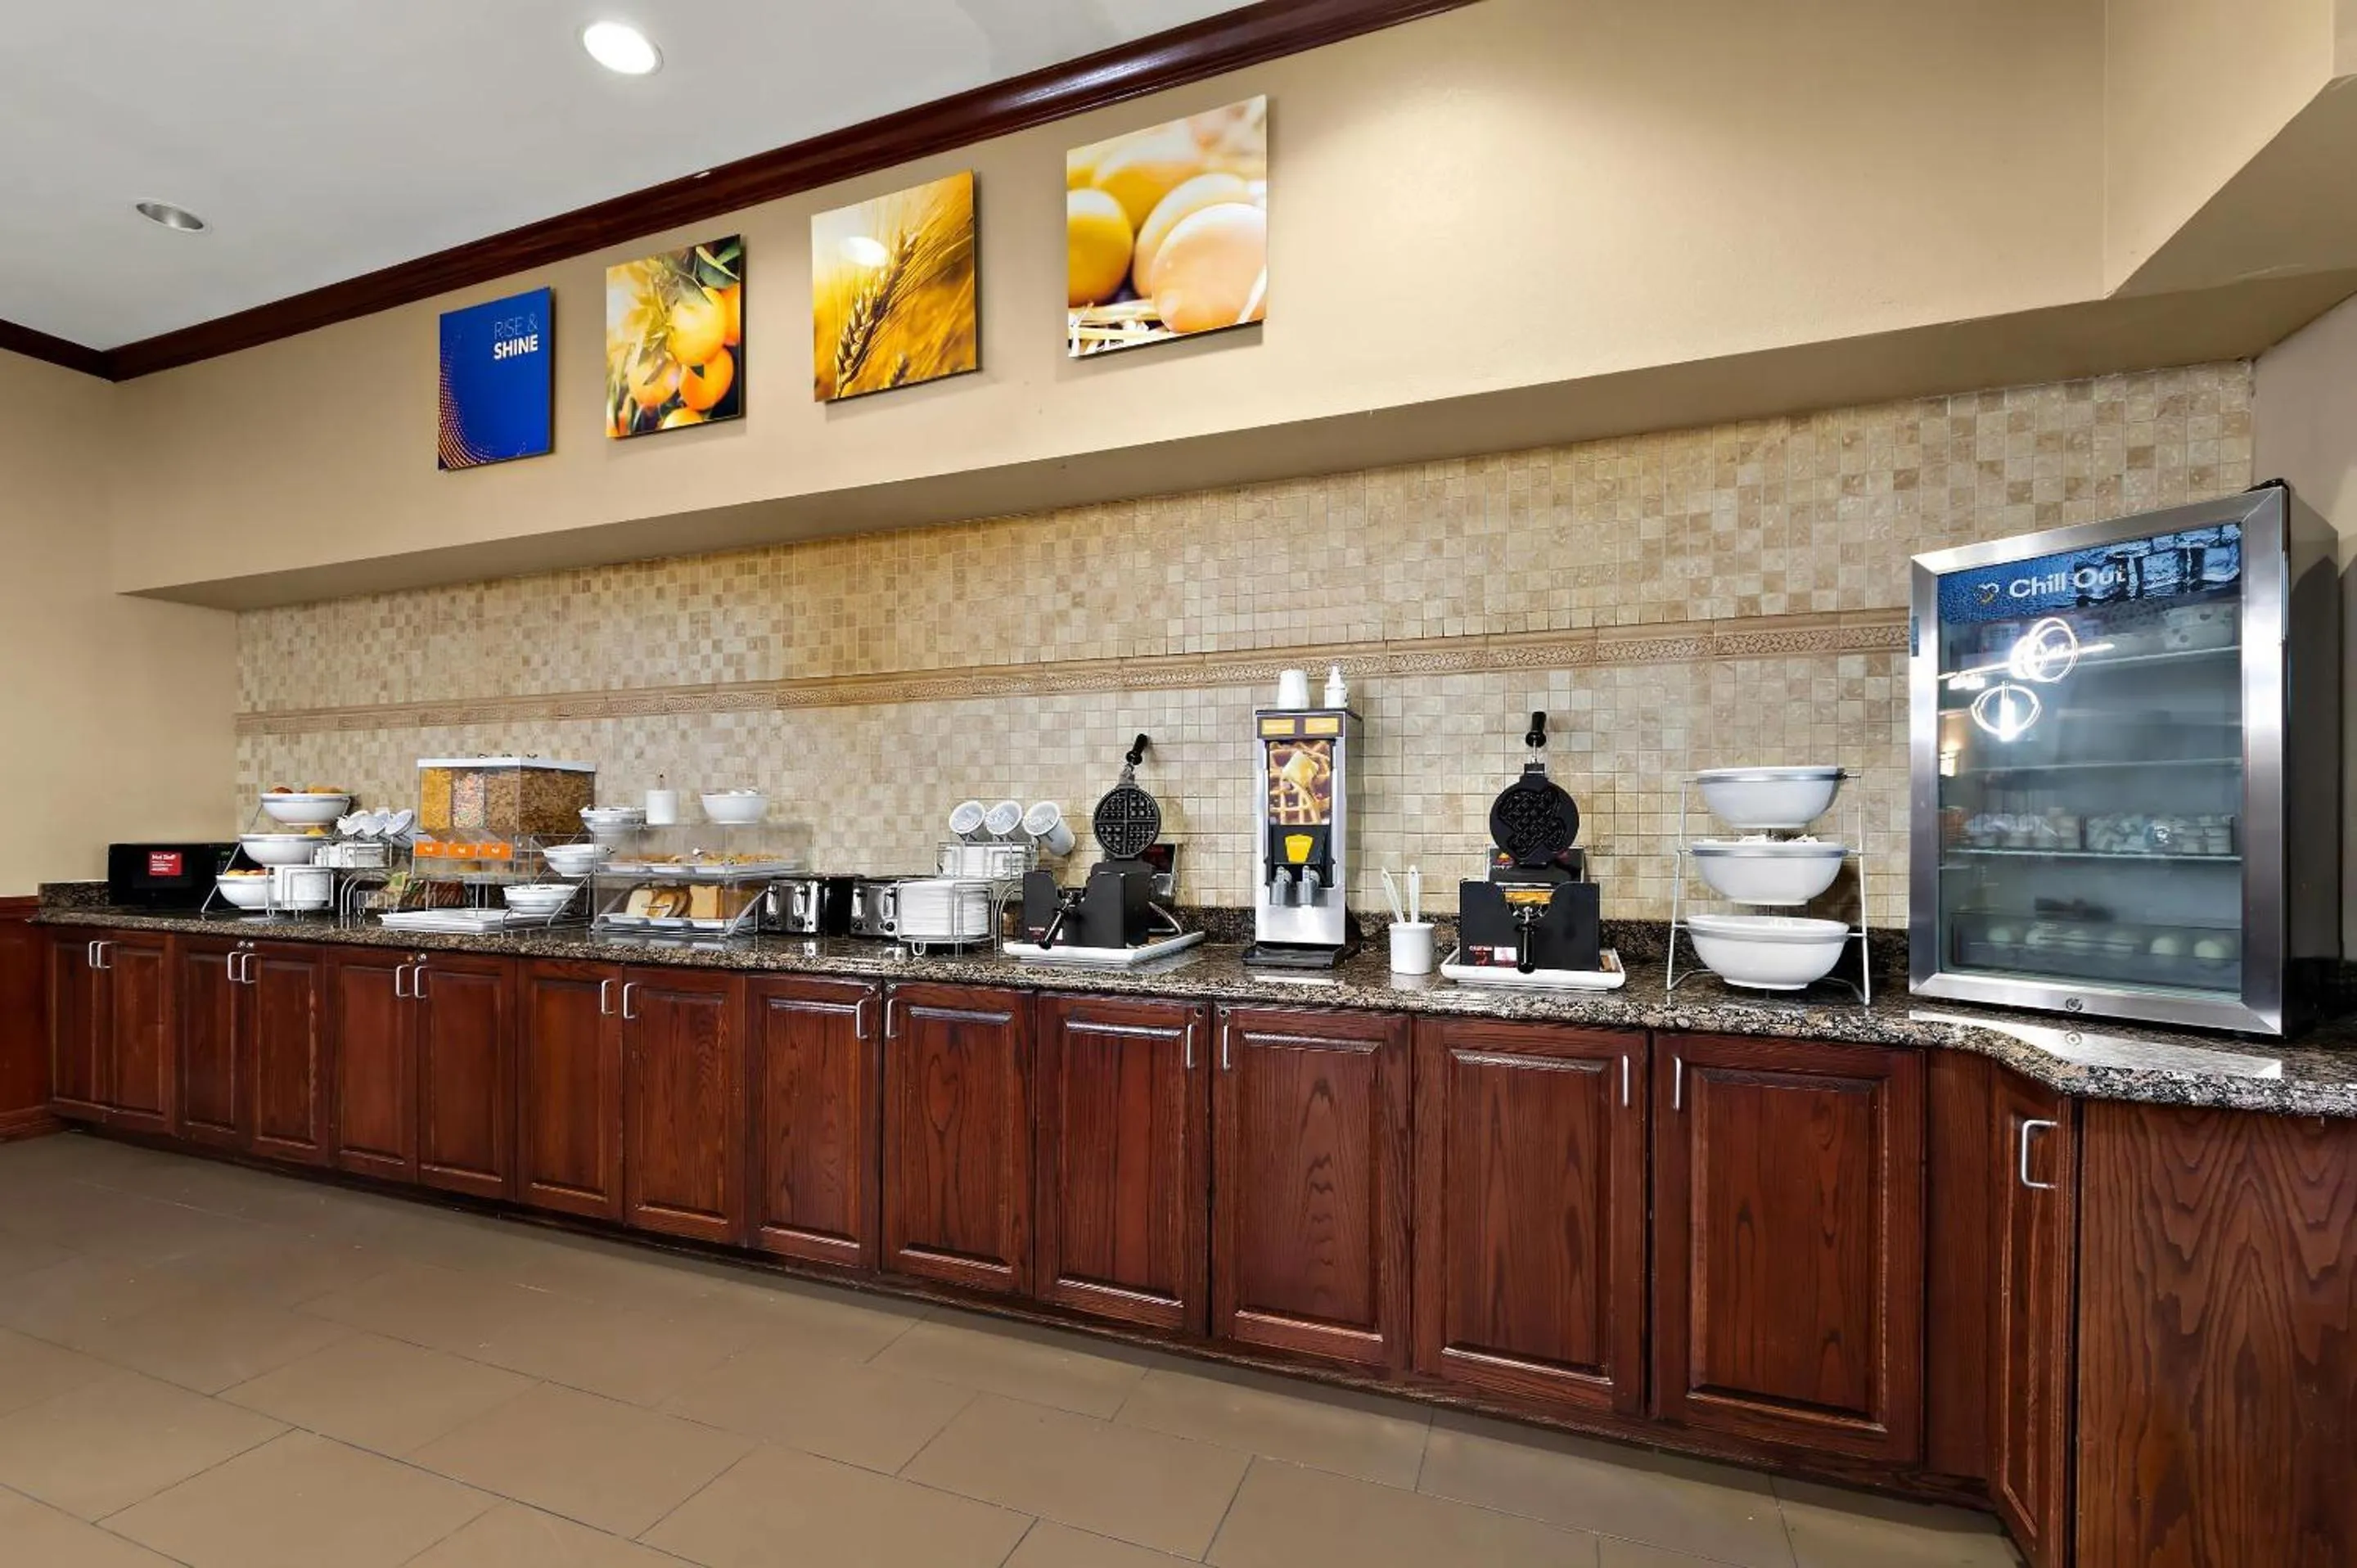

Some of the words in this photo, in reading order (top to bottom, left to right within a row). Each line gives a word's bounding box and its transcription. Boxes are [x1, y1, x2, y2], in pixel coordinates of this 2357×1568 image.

[494, 317, 524, 340] RISE
[527, 313, 539, 332] &
[493, 334, 539, 360] SHINE
[2009, 572, 2066, 598] Chill
[2074, 565, 2125, 589] Out
